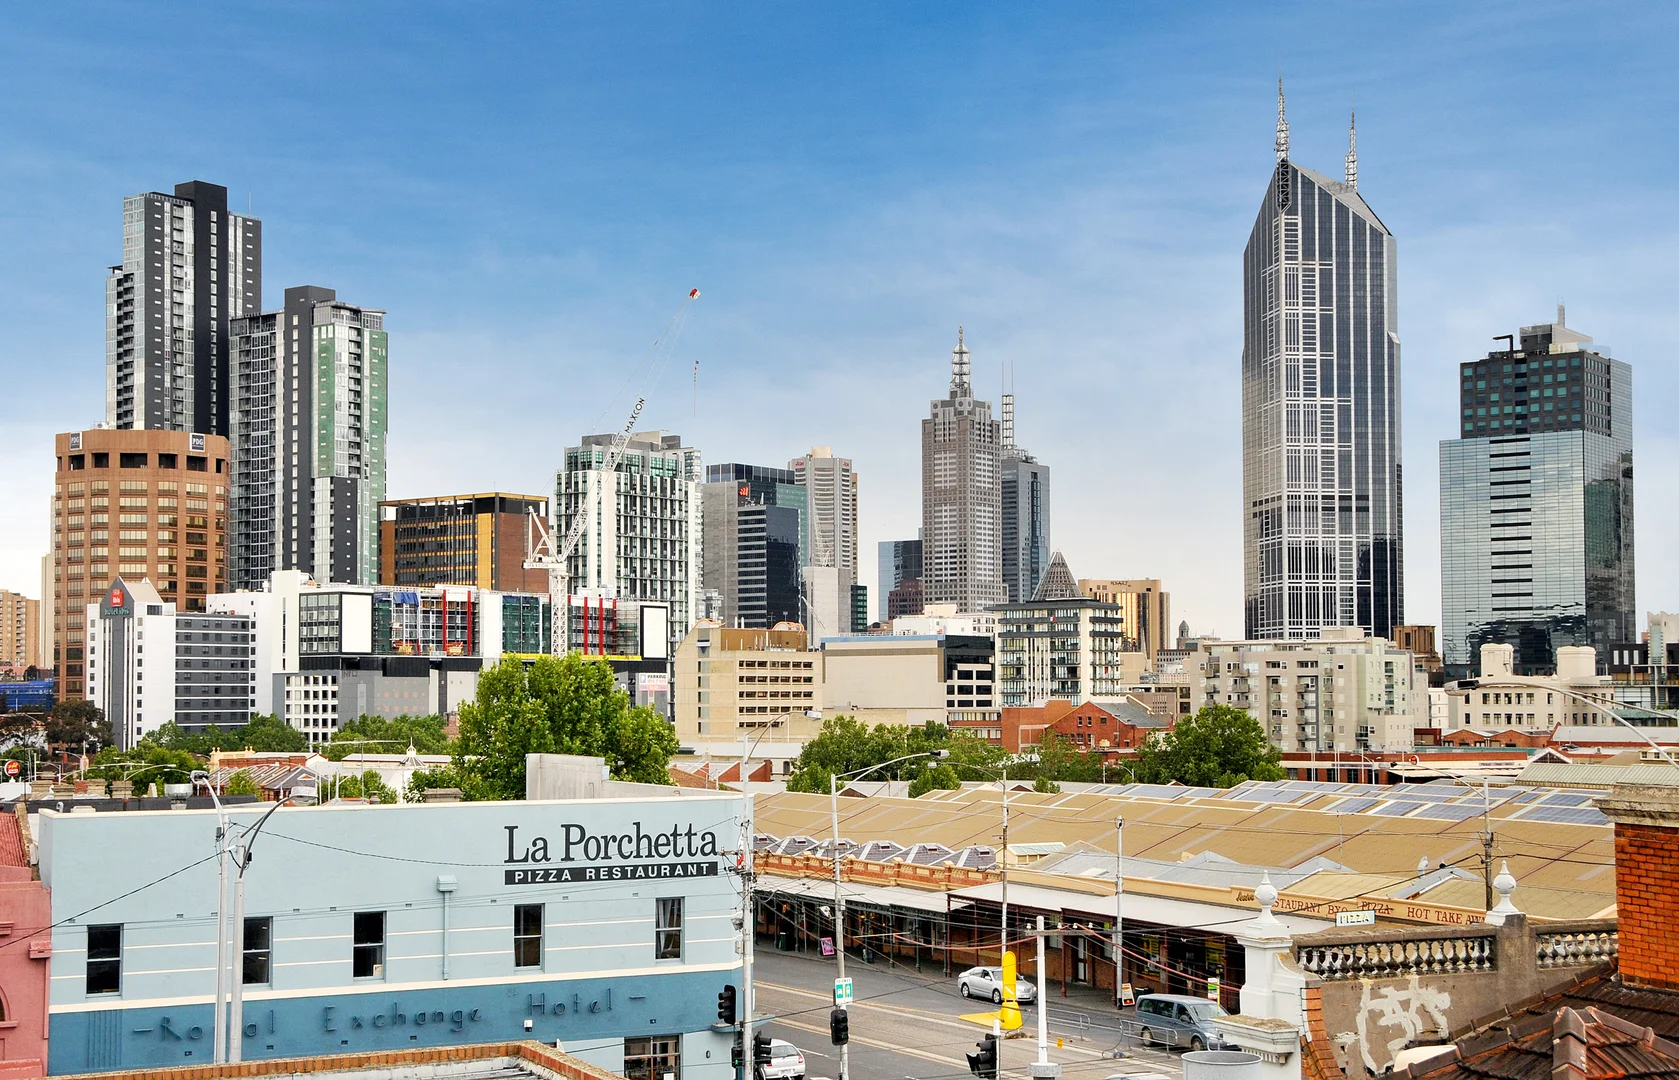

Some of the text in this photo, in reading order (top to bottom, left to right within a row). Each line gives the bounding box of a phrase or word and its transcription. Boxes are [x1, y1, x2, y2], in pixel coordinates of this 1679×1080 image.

[624, 397, 645, 434] MAXCON
[192, 437, 204, 446] PDG
[504, 821, 720, 864] La Porchetta
[514, 863, 710, 883] PIZZA RESTAURANT
[1271, 897, 1322, 914] STAURANT
[1339, 912, 1371, 924] PIZZA
[1407, 906, 1486, 925] HOT TAKE AWA
[159, 987, 614, 1042] Roal Exchange Hotel
